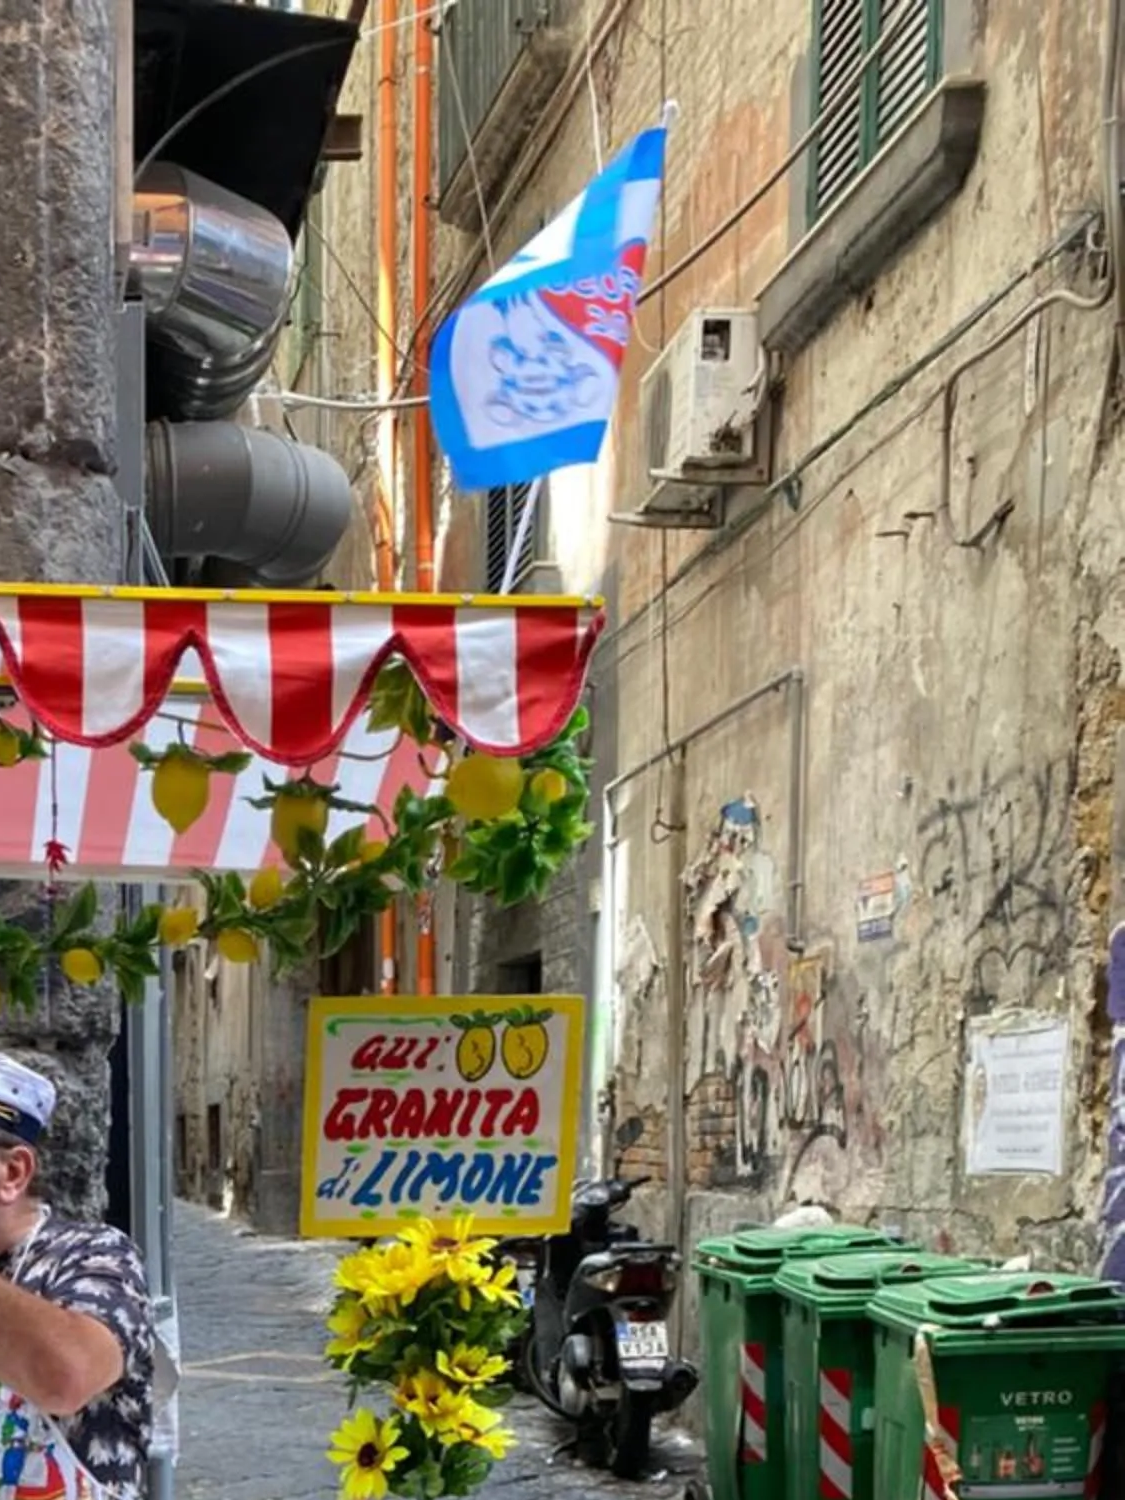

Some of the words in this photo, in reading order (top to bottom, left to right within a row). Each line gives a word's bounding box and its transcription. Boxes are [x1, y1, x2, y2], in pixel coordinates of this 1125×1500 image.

[324, 1087, 540, 1141] GRANITA
[316, 1156, 360, 1199] di
[350, 1150, 557, 1206] LIMONE
[1000, 1391, 1073, 1406] VETRO
